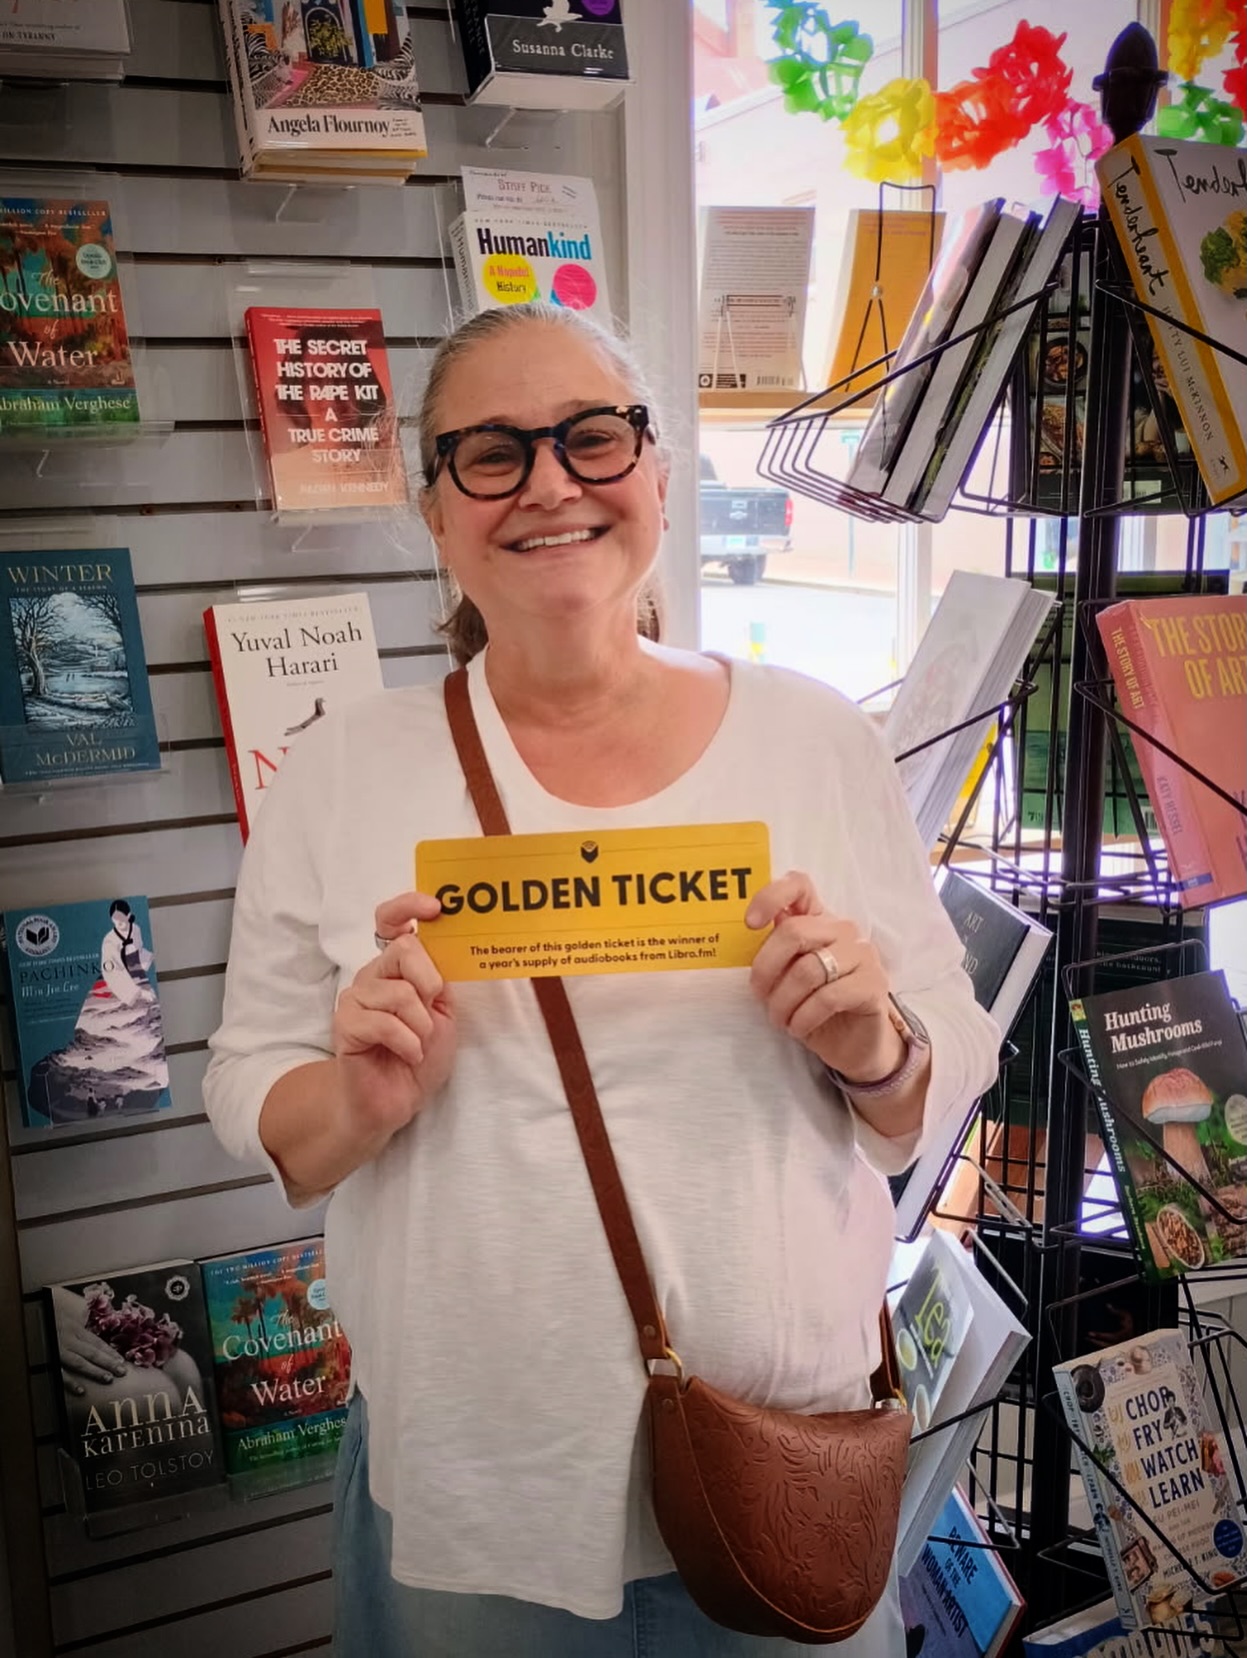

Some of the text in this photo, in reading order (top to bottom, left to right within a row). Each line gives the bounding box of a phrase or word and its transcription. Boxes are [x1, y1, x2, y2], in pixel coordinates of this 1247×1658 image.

[512, 39, 614, 59] Susanna Clarke
[268, 114, 321, 137] Angela
[323, 115, 390, 136] Flournoy
[1107, 155, 1169, 296] Tenderheart
[476, 227, 592, 261] Humankind
[496, 281, 526, 293] History
[43, 319, 60, 340] of
[7, 340, 98, 369] Water
[274, 338, 368, 356] THE SECRET
[276, 361, 372, 379] HISTORY OF
[63, 394, 131, 414] Verghese
[275, 384, 379, 401] THE RAPE KIT
[324, 407, 338, 422] A
[287, 427, 379, 443] TRUE CRIME
[312, 449, 362, 464] STORY
[8, 563, 114, 584] WINTER
[231, 621, 363, 653] Yuval Noah
[1148, 611, 1247, 658] THE STOR
[265, 652, 340, 678] Harari
[1116, 646, 1135, 681] STORY
[1125, 674, 1139, 691] OF
[1183, 658, 1213, 700] OF
[1130, 687, 1146, 710] ART
[66, 731, 103, 747] VAL
[35, 746, 136, 768] McDERMID
[434, 867, 753, 916] GOLDEN TICKET
[469, 932, 720, 957] The bearer of this golden ticket is the winner of
[19, 960, 115, 984] PACHINKO
[479, 947, 717, 971] a year's supply of audiobooks from Libro.fm!
[1104, 1002, 1172, 1032] Hunting
[1110, 1018, 1203, 1054] Mushrooms
[1079, 1028, 1126, 1172] Hunting ushrooms
[222, 1319, 343, 1361] Covenant
[280, 1353, 294, 1374] of
[251, 1373, 326, 1407] Water
[1125, 1385, 1170, 1421] CHOP
[238, 1428, 297, 1452] Abraham
[297, 1416, 347, 1438] Verghes
[1133, 1418, 1164, 1451] FRY
[85, 1468, 124, 1491] LEO
[130, 1448, 215, 1482] TOLSTOY
[1140, 1438, 1199, 1480] WATCH
[1149, 1467, 1205, 1510] LEARN
[920, 1543, 949, 1600] WOMAN
[942, 1588, 970, 1638] ARTIST
